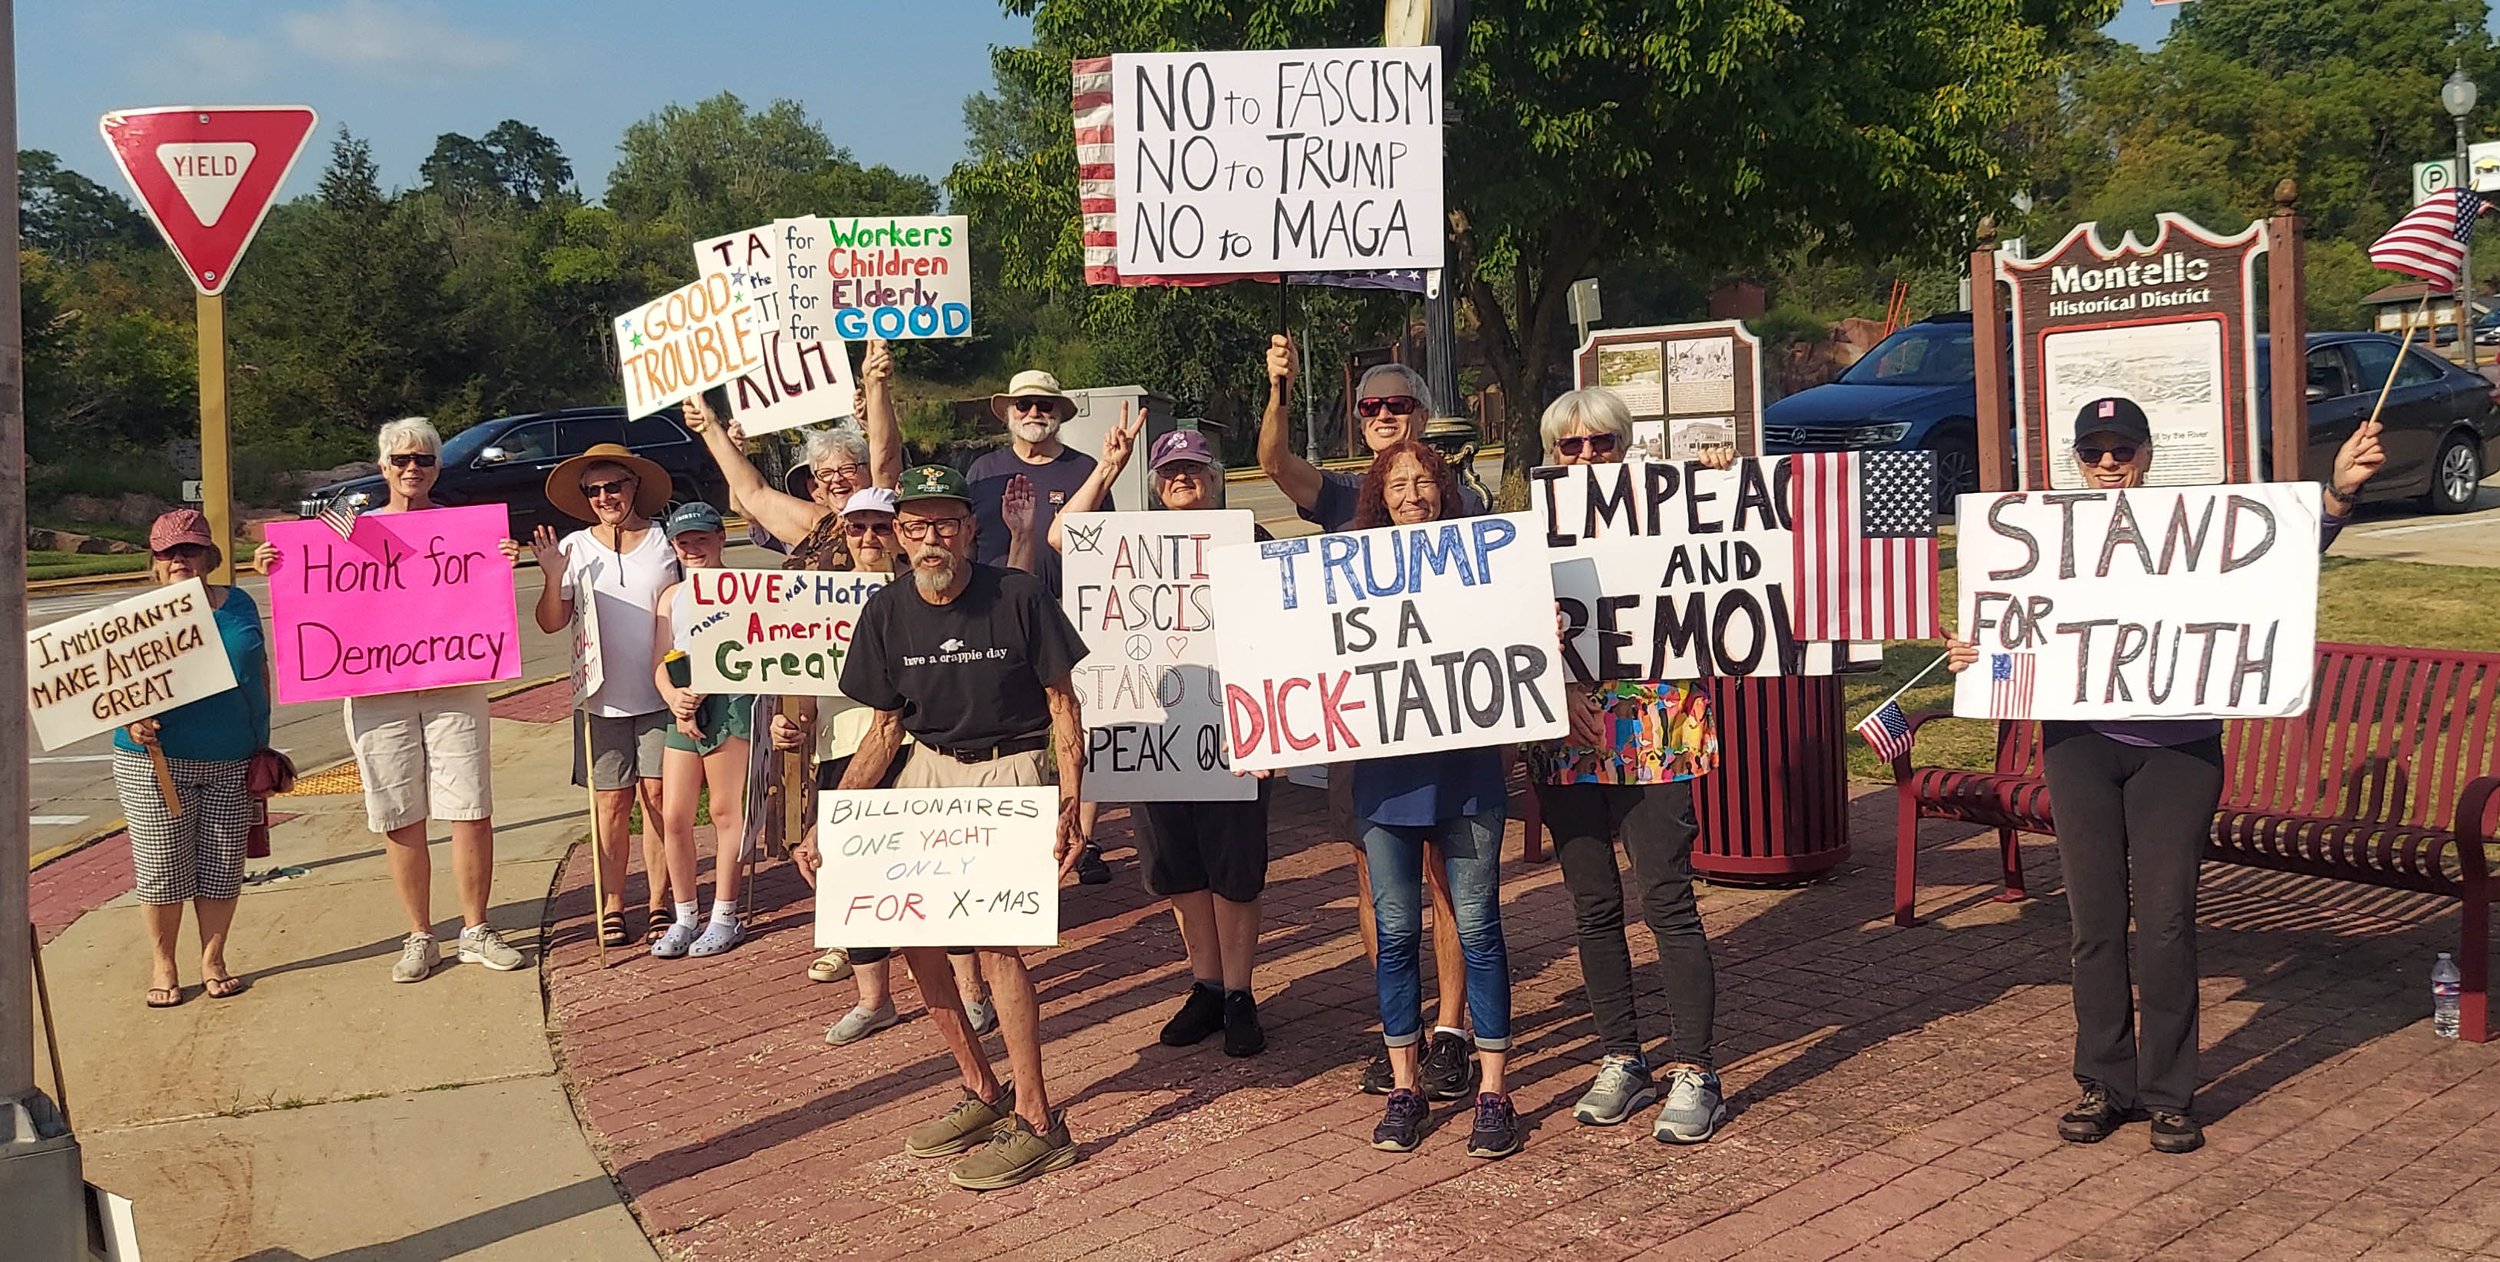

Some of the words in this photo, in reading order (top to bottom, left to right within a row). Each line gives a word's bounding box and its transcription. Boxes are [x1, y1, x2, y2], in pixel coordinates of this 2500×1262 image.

[1136, 62, 1215, 131] NO
[1225, 91, 1260, 125] to
[1276, 59, 1434, 129] FASCISM
[173, 155, 237, 177] YIELD
[1136, 135, 1218, 194] NO
[1225, 161, 1264, 191] to
[1266, 132, 1407, 194] TRUMP
[2429, 170, 2443, 189] P
[712, 233, 773, 267] TA
[785, 225, 815, 250] for
[829, 219, 953, 248] Workers
[1131, 201, 1204, 264] NO
[1219, 229, 1252, 260] to
[1273, 197, 1412, 260] MAGA
[787, 253, 817, 279] for
[828, 248, 948, 279] Children
[2050, 252, 2210, 295] Montello
[644, 272, 731, 341] GOOD
[789, 284, 819, 310] for
[832, 279, 938, 316] Elderly
[790, 313, 819, 340] for
[834, 302, 971, 339] GOOD
[2049, 293, 2136, 317] Historical
[2141, 288, 2210, 308] District
[623, 306, 758, 407] TROUBLE
[1532, 456, 1793, 547] IMPEAC
[1112, 534, 1211, 580] ANTI
[1986, 490, 2277, 581] STAND
[303, 538, 406, 594] Honk
[424, 535, 486, 588] for
[1260, 518, 1517, 610] TRUMP
[1661, 540, 1762, 588] AND
[693, 572, 784, 606] LOVE
[1078, 584, 1215, 632] FASCIS
[30, 594, 194, 669] IMMIGRANTS
[297, 622, 505, 681] Democracy
[747, 612, 852, 646] Americ
[1331, 606, 1378, 656] IS
[1397, 600, 1432, 648] A
[1971, 591, 2053, 649] FOR
[2056, 617, 2280, 707] TRUTH
[32, 664, 100, 709] MAKE
[106, 624, 203, 686] AMERICA
[715, 640, 845, 682] Great
[929, 655, 938, 664] a
[940, 649, 983, 664] crappie
[986, 648, 1008, 660] day
[92, 669, 175, 720] GREAT
[1208, 664, 1224, 707] U
[1225, 644, 1557, 759] DICK-TATOR
[1082, 724, 1182, 773] PEAK
[1197, 723, 1231, 772] OU
[830, 798, 1039, 825] BILLIONAIRES
[843, 831, 904, 857] ONE
[919, 825, 998, 850] YACHT
[886, 857, 977, 881] ONLY
[845, 892, 927, 927] FOR
[948, 889, 1041, 921] X-MAS
